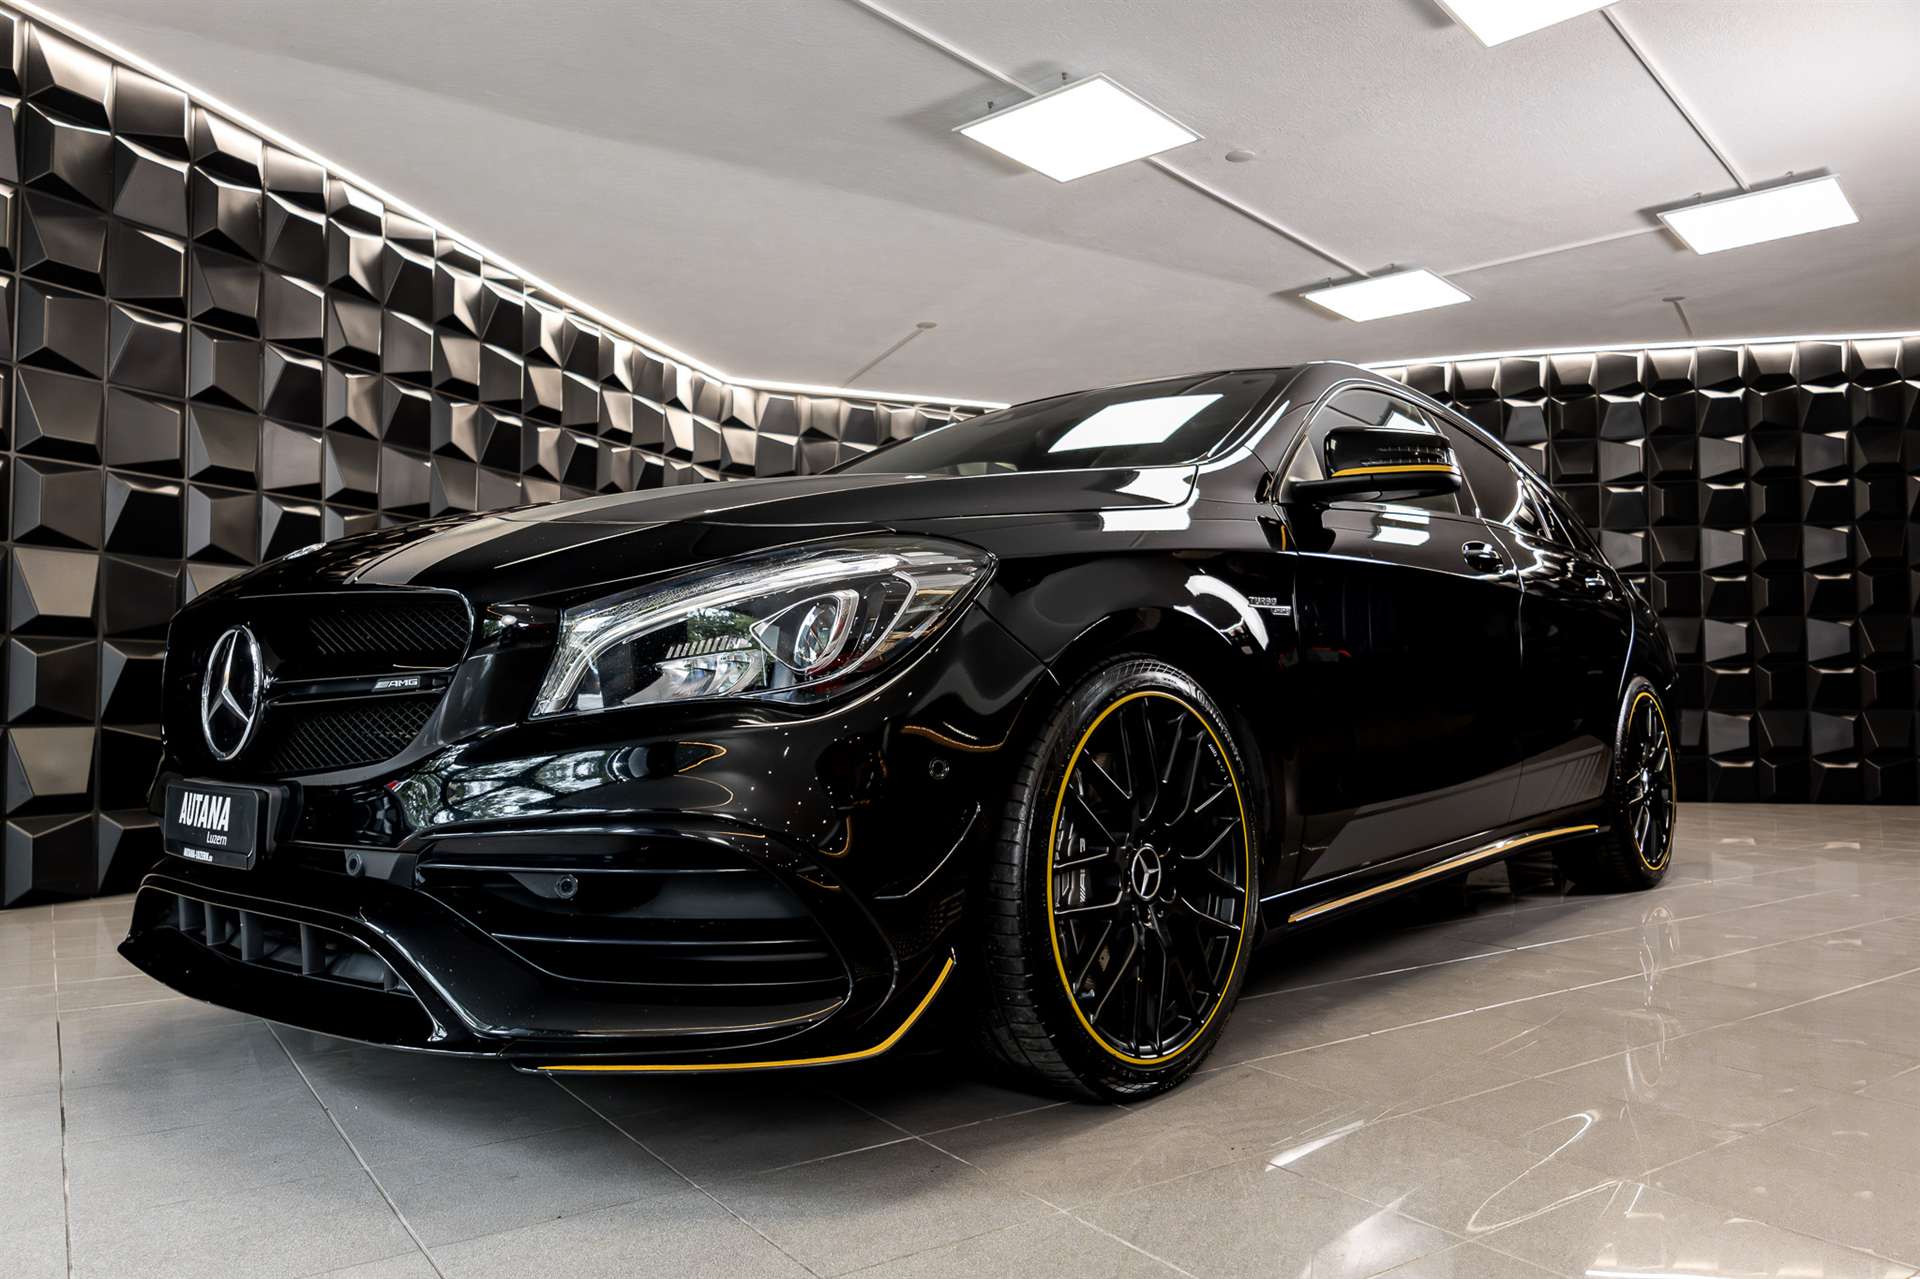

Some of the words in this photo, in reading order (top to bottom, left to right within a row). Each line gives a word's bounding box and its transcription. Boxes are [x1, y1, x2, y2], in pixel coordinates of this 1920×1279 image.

[387, 678, 418, 688] AMG
[178, 791, 231, 832] AUTANA
[206, 831, 228, 847] Luzern
